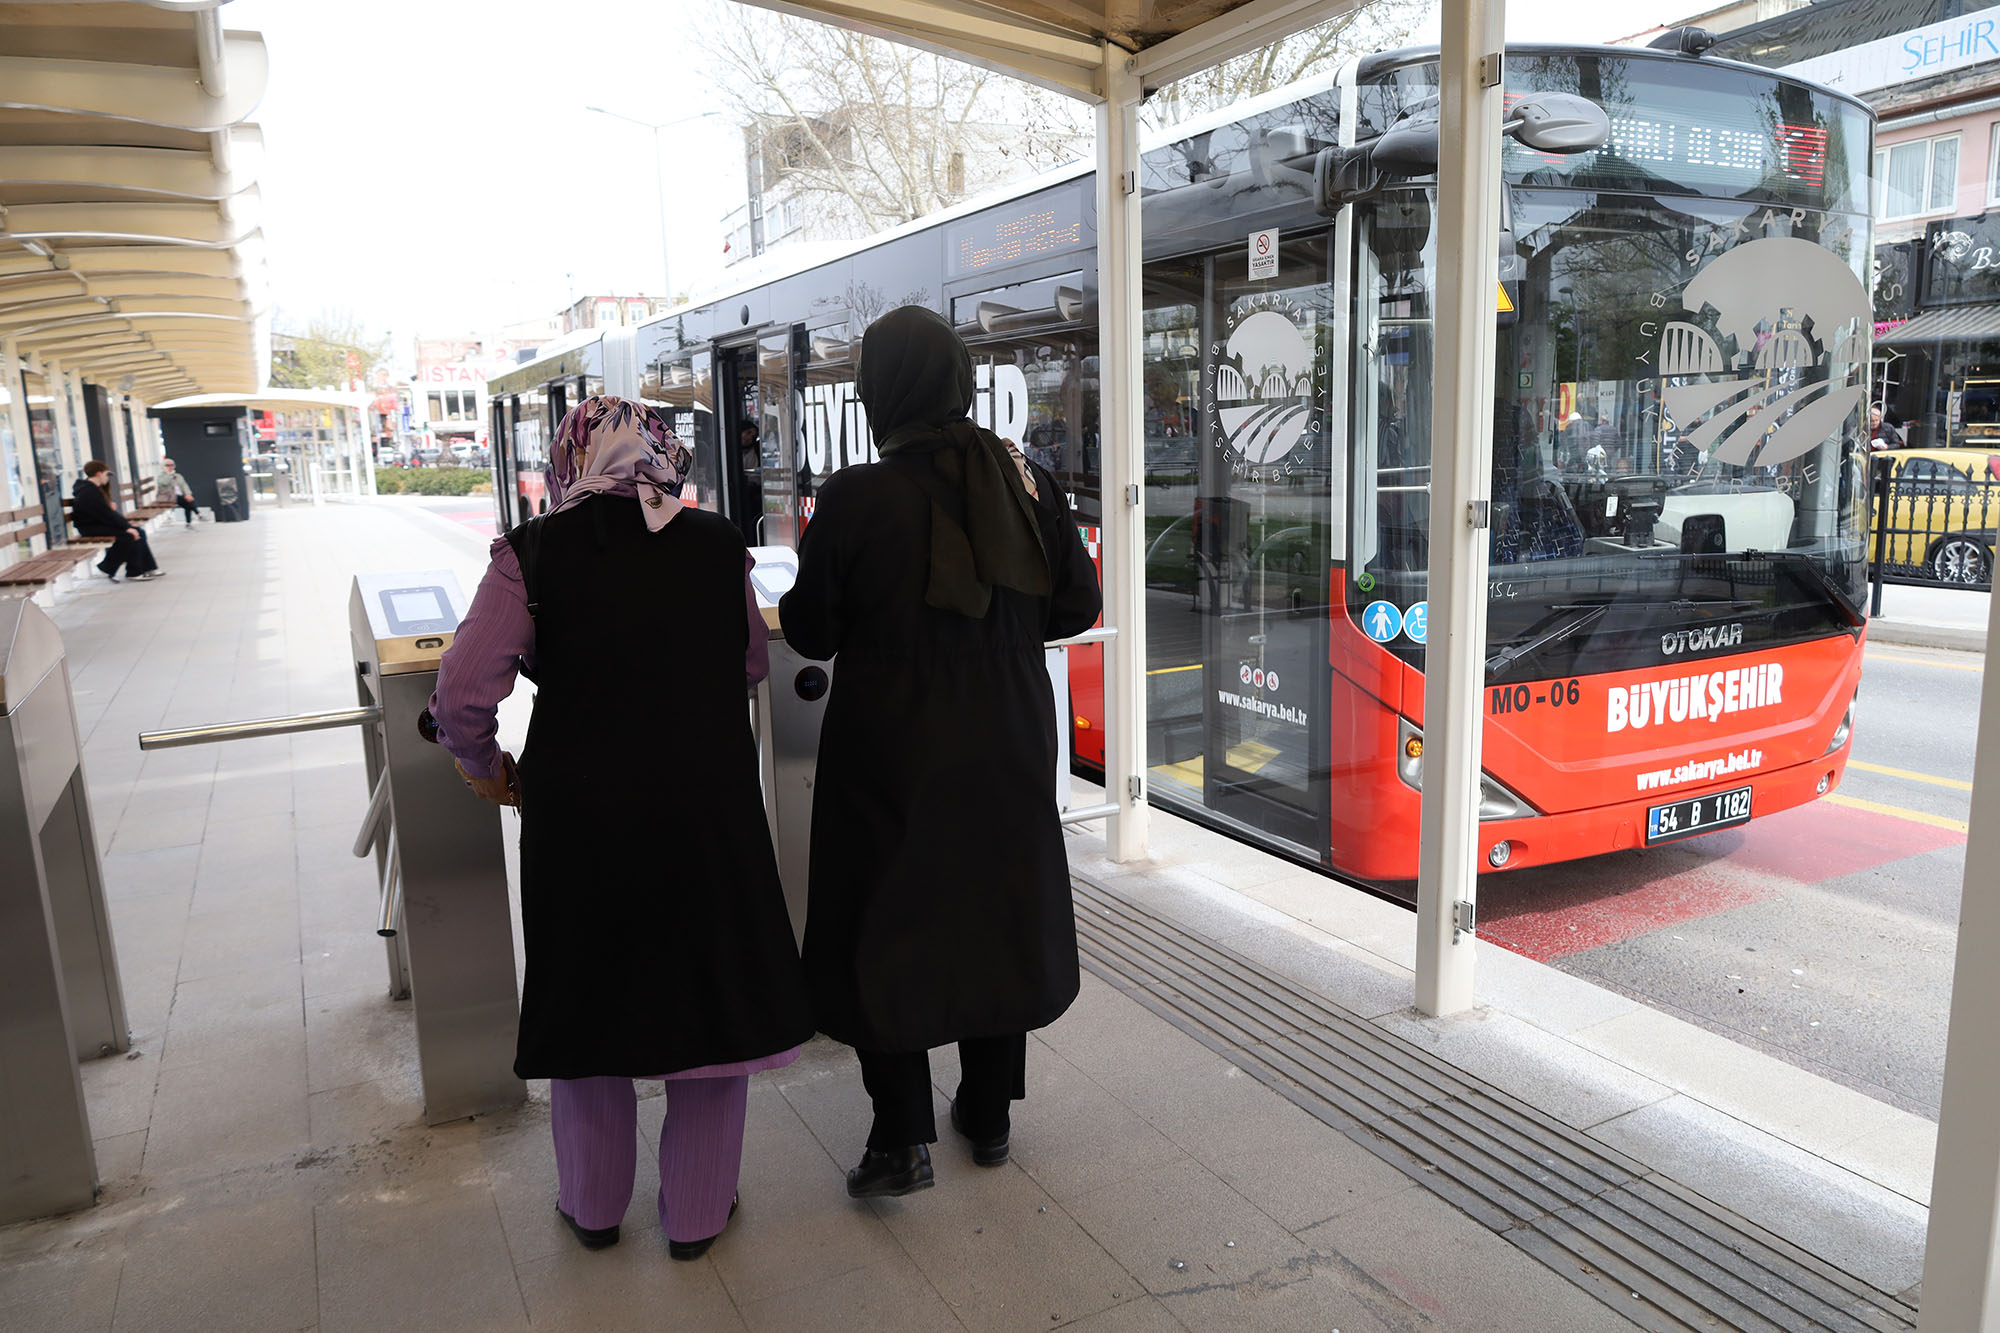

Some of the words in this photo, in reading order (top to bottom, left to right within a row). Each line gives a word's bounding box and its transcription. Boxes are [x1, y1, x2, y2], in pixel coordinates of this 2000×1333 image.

[1685, 207, 1853, 268] SAKARYA
[1226, 293, 1303, 329] SAKARYA
[1205, 343, 1261, 484] BÜYÜKŞEHİR
[1272, 330, 1328, 483] BELEDİYESİ
[1661, 623, 1743, 655] OTOKAR
[1218, 690, 1307, 726] www.sakarya.bel.tr
[1607, 663, 1783, 733] BÜYÜKŞEHİR
[1637, 748, 1762, 791] www.sakarya.bel.tr
[1659, 808, 1678, 833] 54
[1691, 801, 1702, 826] B
[1715, 790, 1749, 820] 1182
